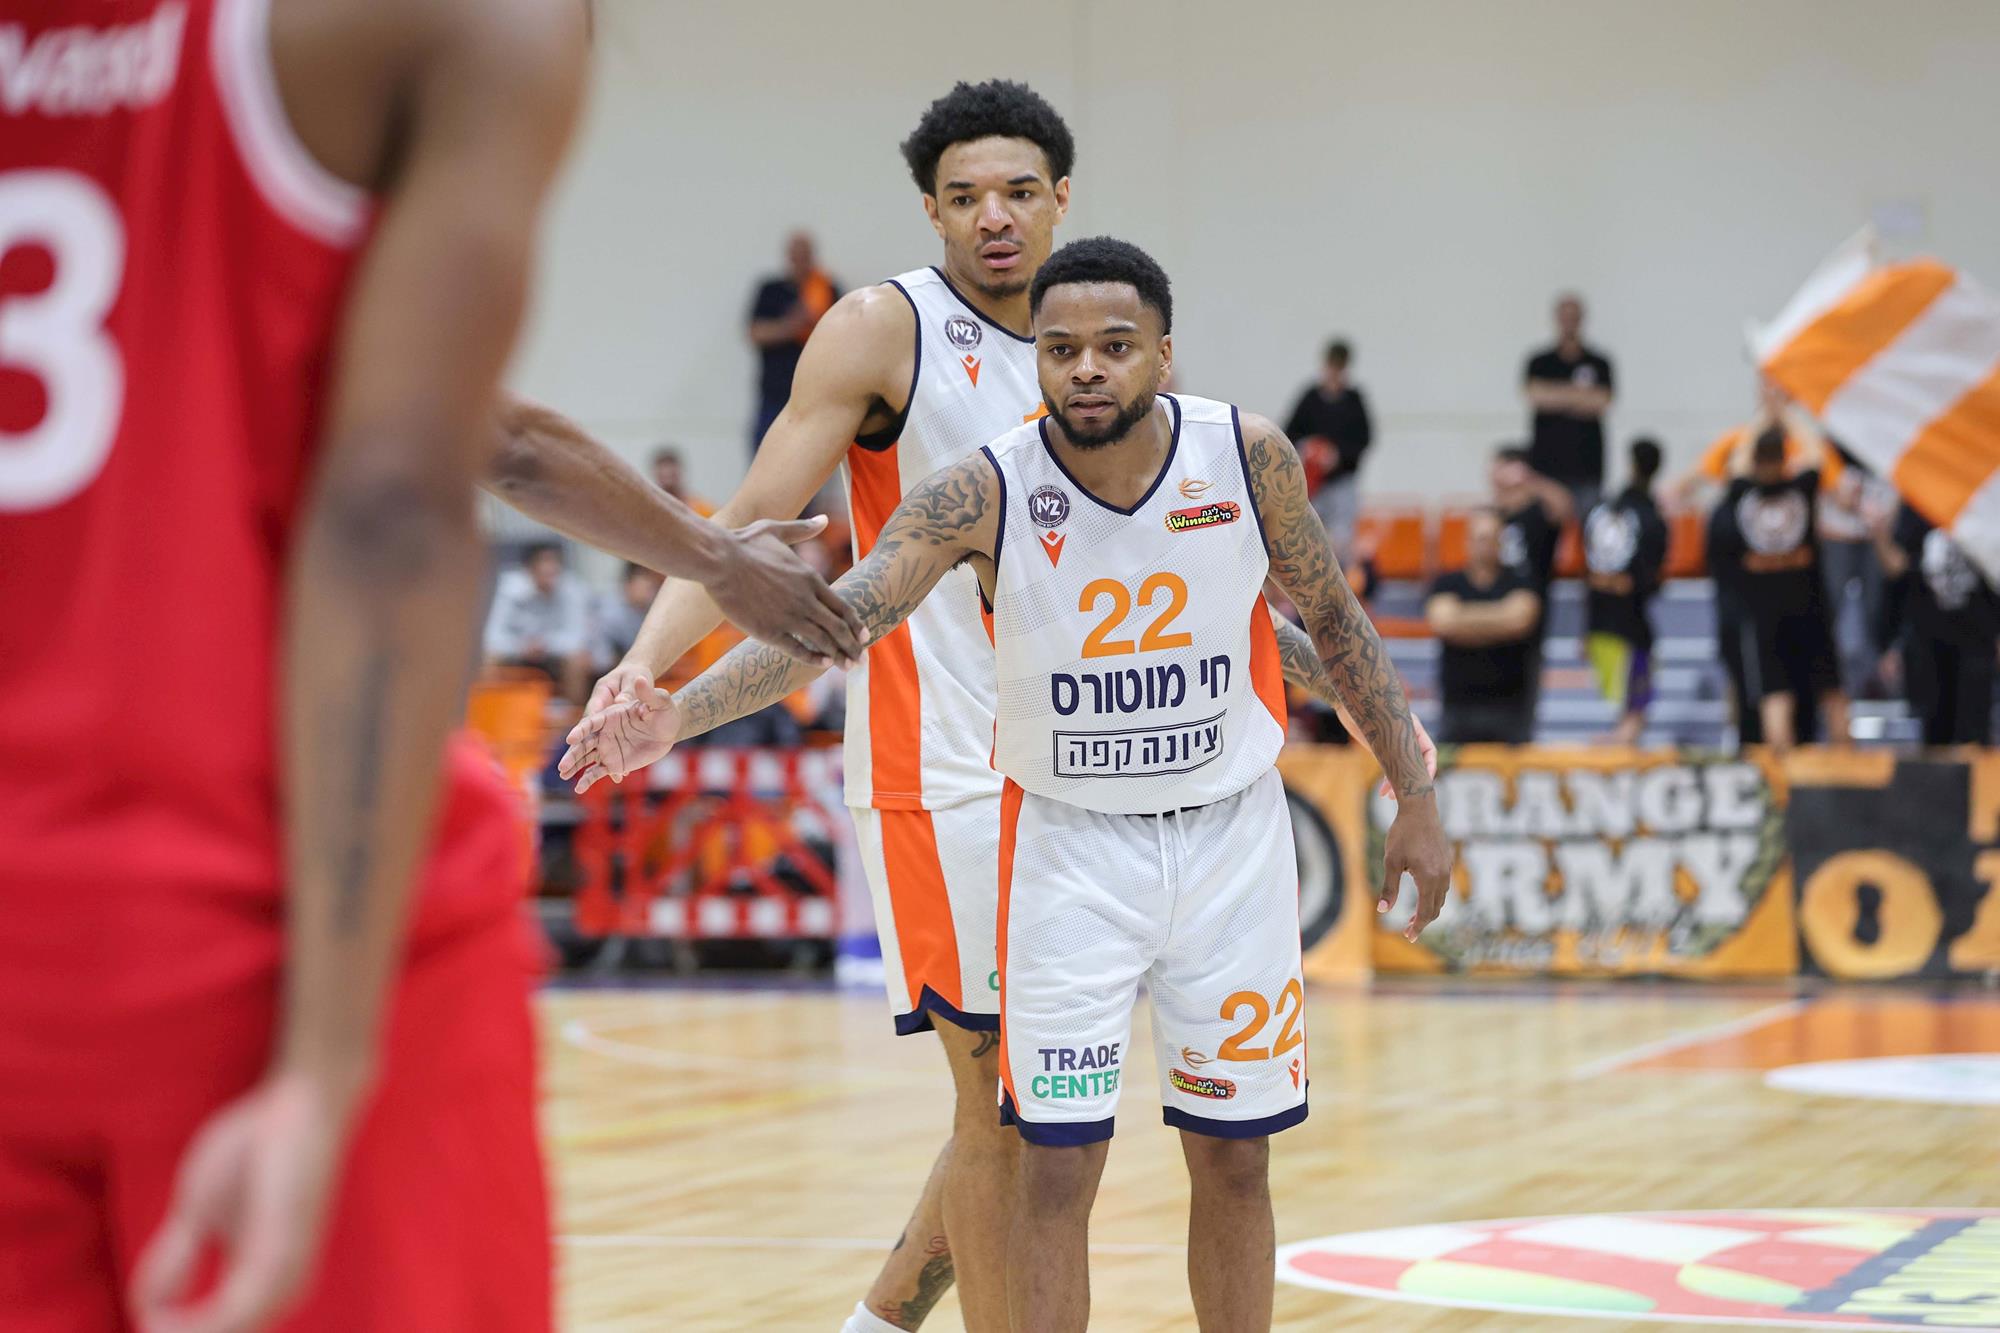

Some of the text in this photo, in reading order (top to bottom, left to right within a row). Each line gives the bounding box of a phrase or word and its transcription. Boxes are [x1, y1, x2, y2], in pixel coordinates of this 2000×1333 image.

[951, 322, 975, 340] NZ
[1036, 496, 1060, 515] NZ
[1171, 511, 1232, 528] Winner סל
[1201, 505, 1219, 517] ליגת
[1078, 571, 1193, 660] 22
[1051, 654, 1231, 715] חי מוטורס
[1069, 724, 1219, 772] ציונה קפה
[1381, 832, 1761, 931] RMY
[1216, 977, 1304, 1062] 22
[1038, 1042, 1120, 1072] TRADE
[1173, 1074, 1214, 1095] Winner
